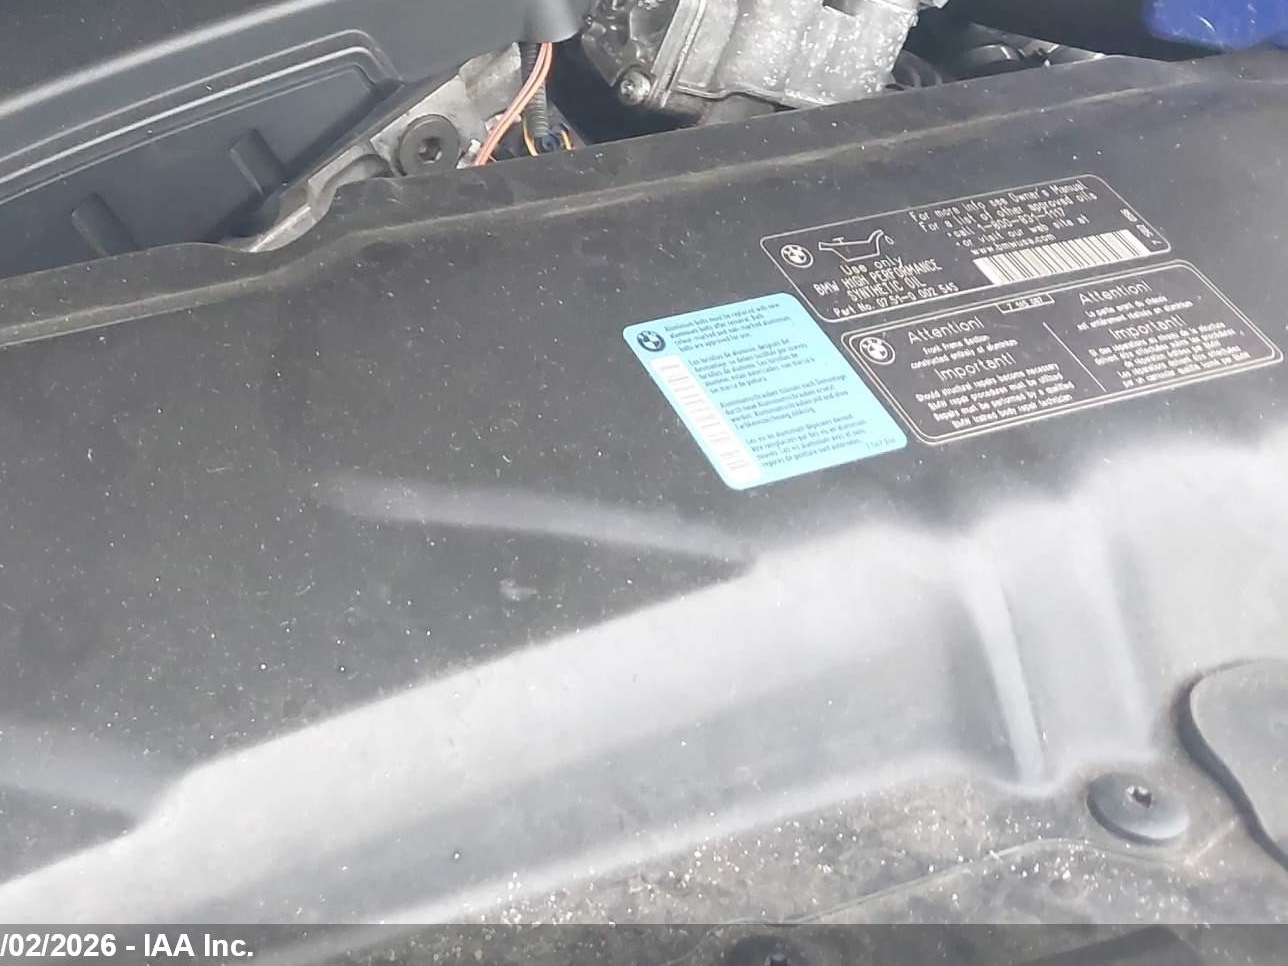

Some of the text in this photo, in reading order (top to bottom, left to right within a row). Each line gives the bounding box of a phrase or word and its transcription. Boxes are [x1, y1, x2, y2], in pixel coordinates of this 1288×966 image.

[909, 180, 1088, 222] For more info see Owner's Manual
[918, 189, 1097, 232] For a list of other approved oils
[977, 207, 1066, 232] 1-800-831-1117
[978, 230, 1004, 243] visit
[1007, 229, 1024, 238] our
[1028, 222, 1049, 233] web
[1052, 218, 1074, 229] site
[1077, 214, 1090, 224] at
[970, 230, 1056, 255] www.bmwusa.com
[813, 259, 943, 296] BMW HIGH PERFORMANCE
[840, 255, 903, 276] Use only
[846, 275, 927, 302] SYNTHETIC OIL
[1079, 280, 1152, 305] Attention!
[833, 305, 856, 317] Part
[857, 302, 875, 312] No.
[908, 316, 985, 345] Attention!
[1108, 314, 1187, 340] Important!
[934, 352, 1016, 382] Important!
